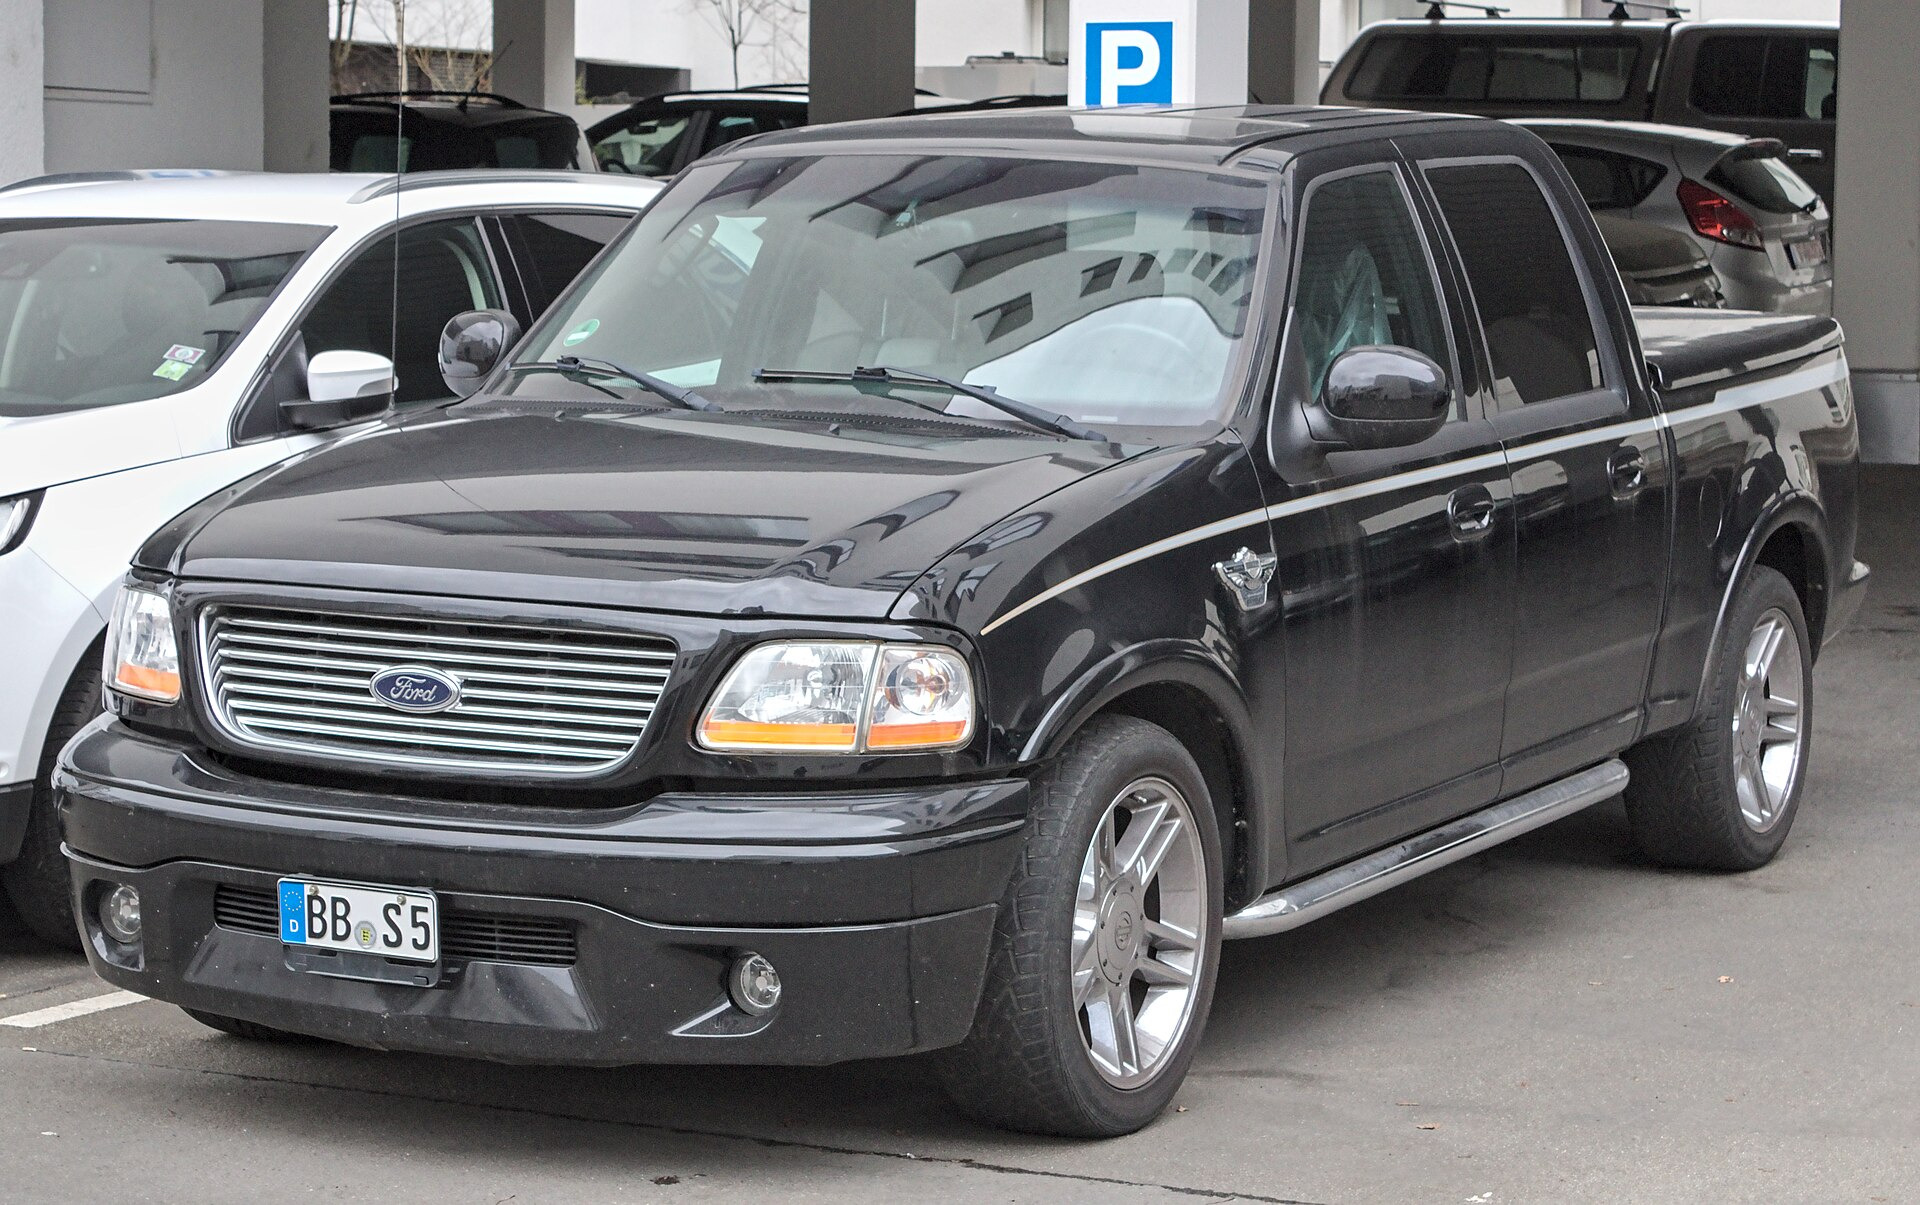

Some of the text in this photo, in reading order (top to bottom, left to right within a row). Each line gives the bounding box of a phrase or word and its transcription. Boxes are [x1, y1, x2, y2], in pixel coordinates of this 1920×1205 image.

[1101, 30, 1160, 106] P
[390, 676, 437, 702] Ford
[289, 919, 299, 932] D
[307, 894, 351, 941] BB
